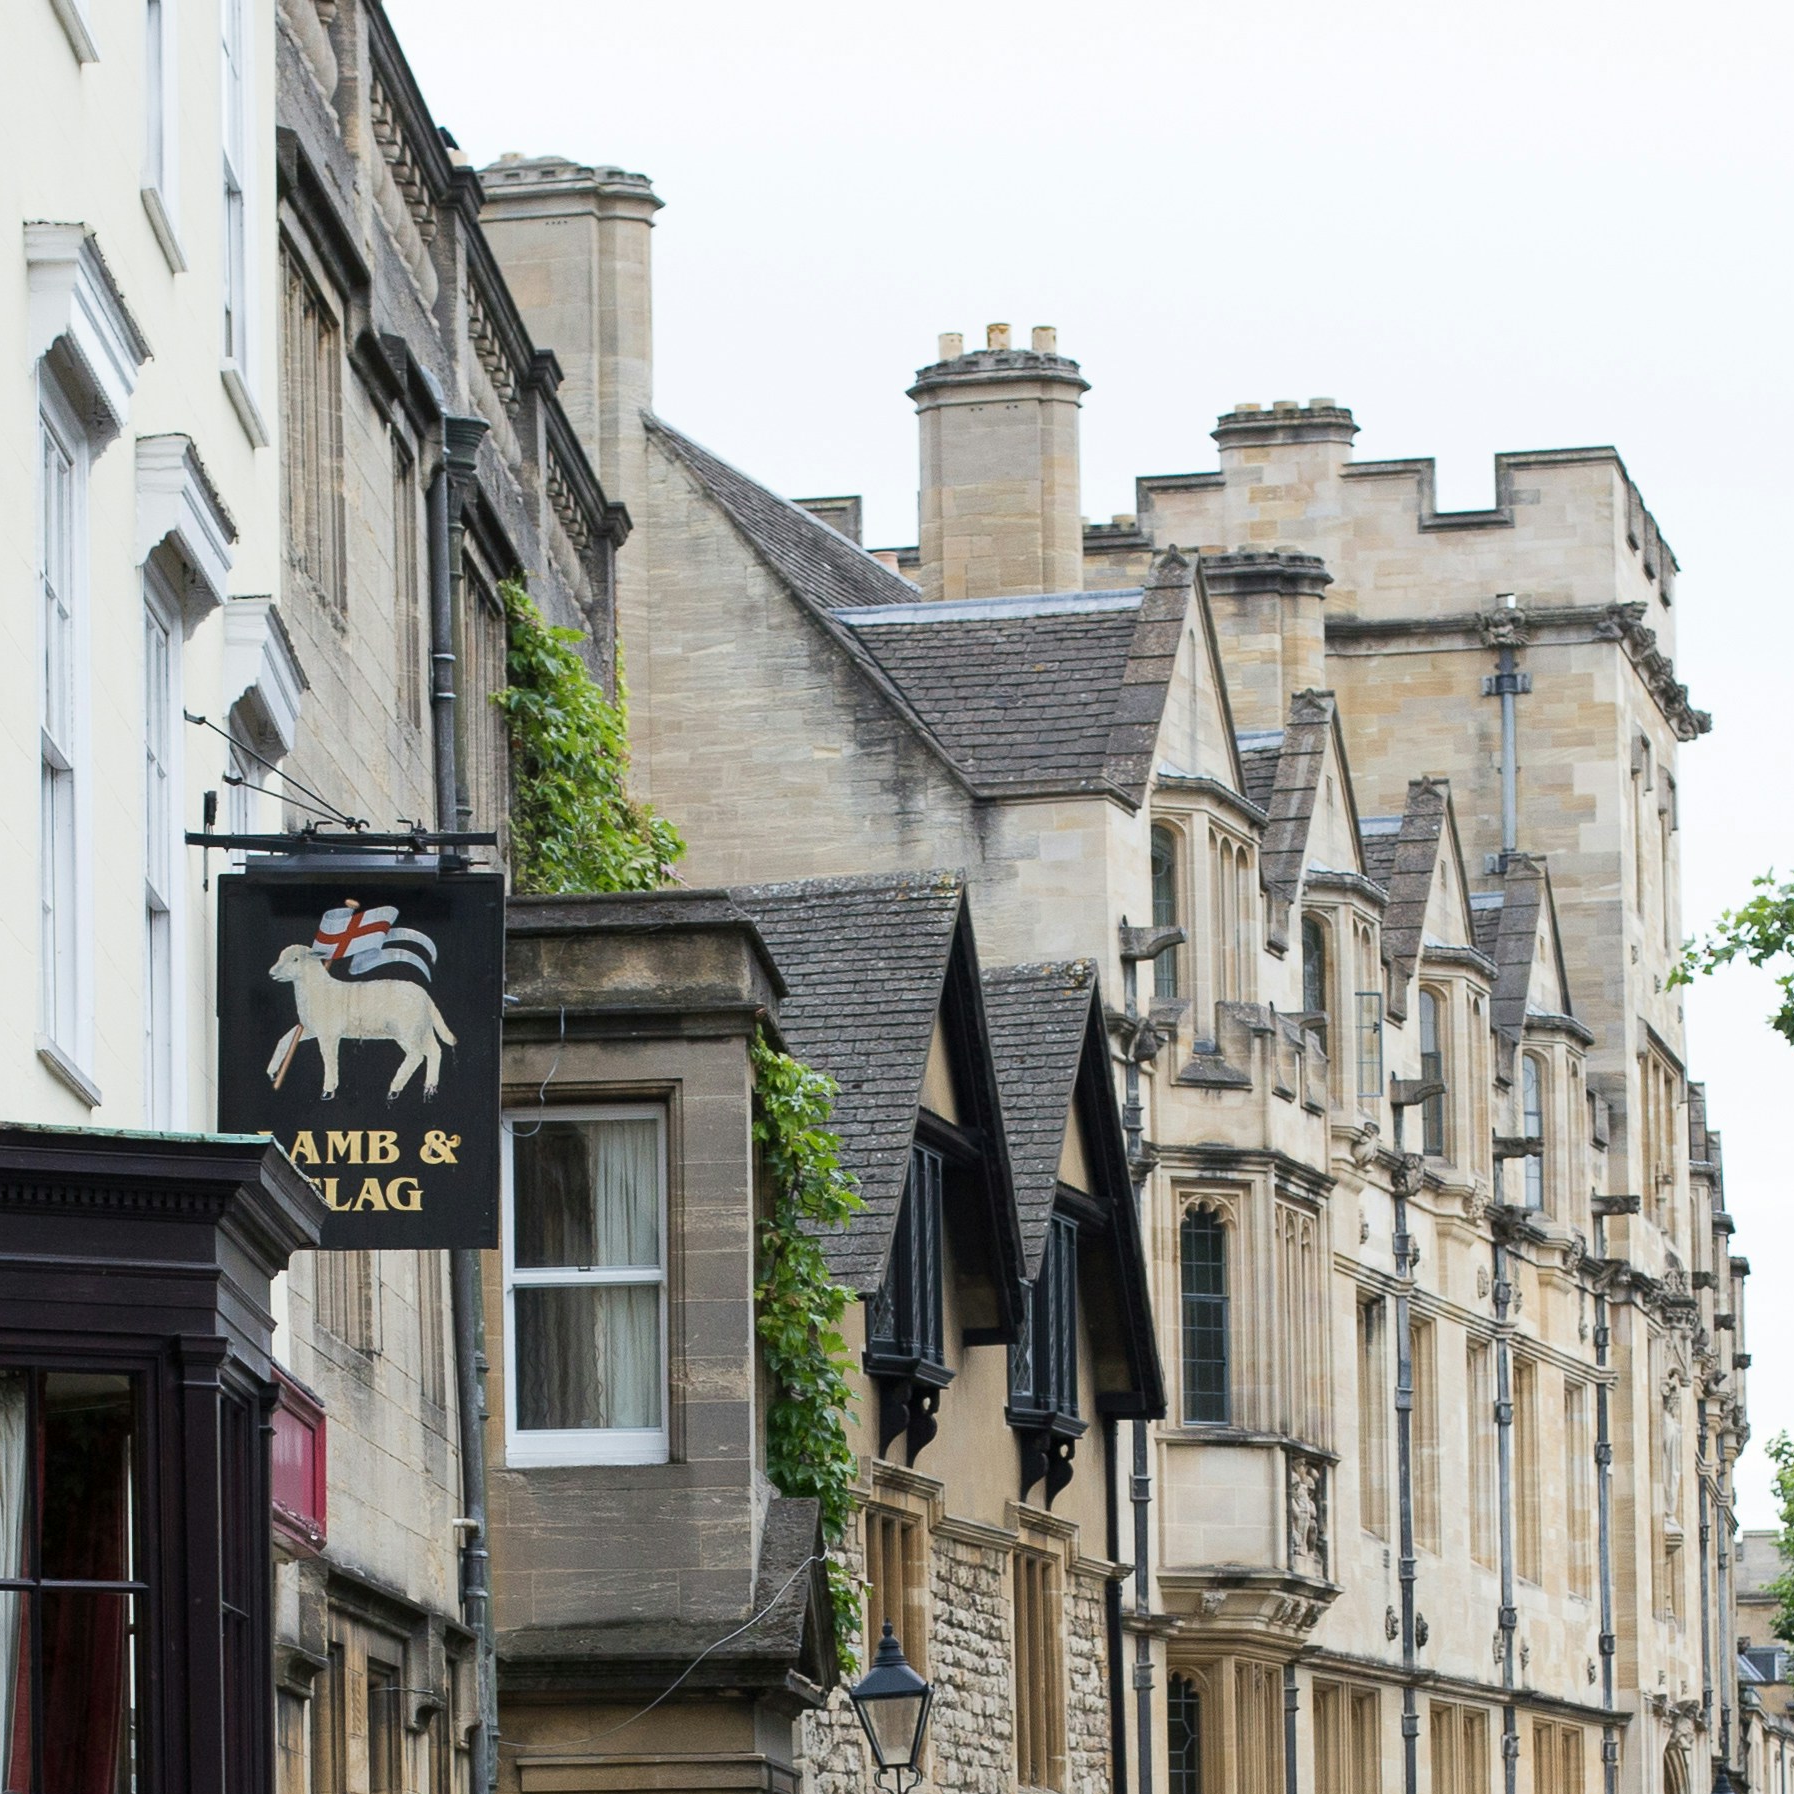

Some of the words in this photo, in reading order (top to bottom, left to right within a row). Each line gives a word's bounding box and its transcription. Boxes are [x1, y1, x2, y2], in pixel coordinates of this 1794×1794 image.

[257, 1131, 401, 1165] AMB
[419, 1129, 462, 1165] &
[309, 1177, 424, 1212] LAG
